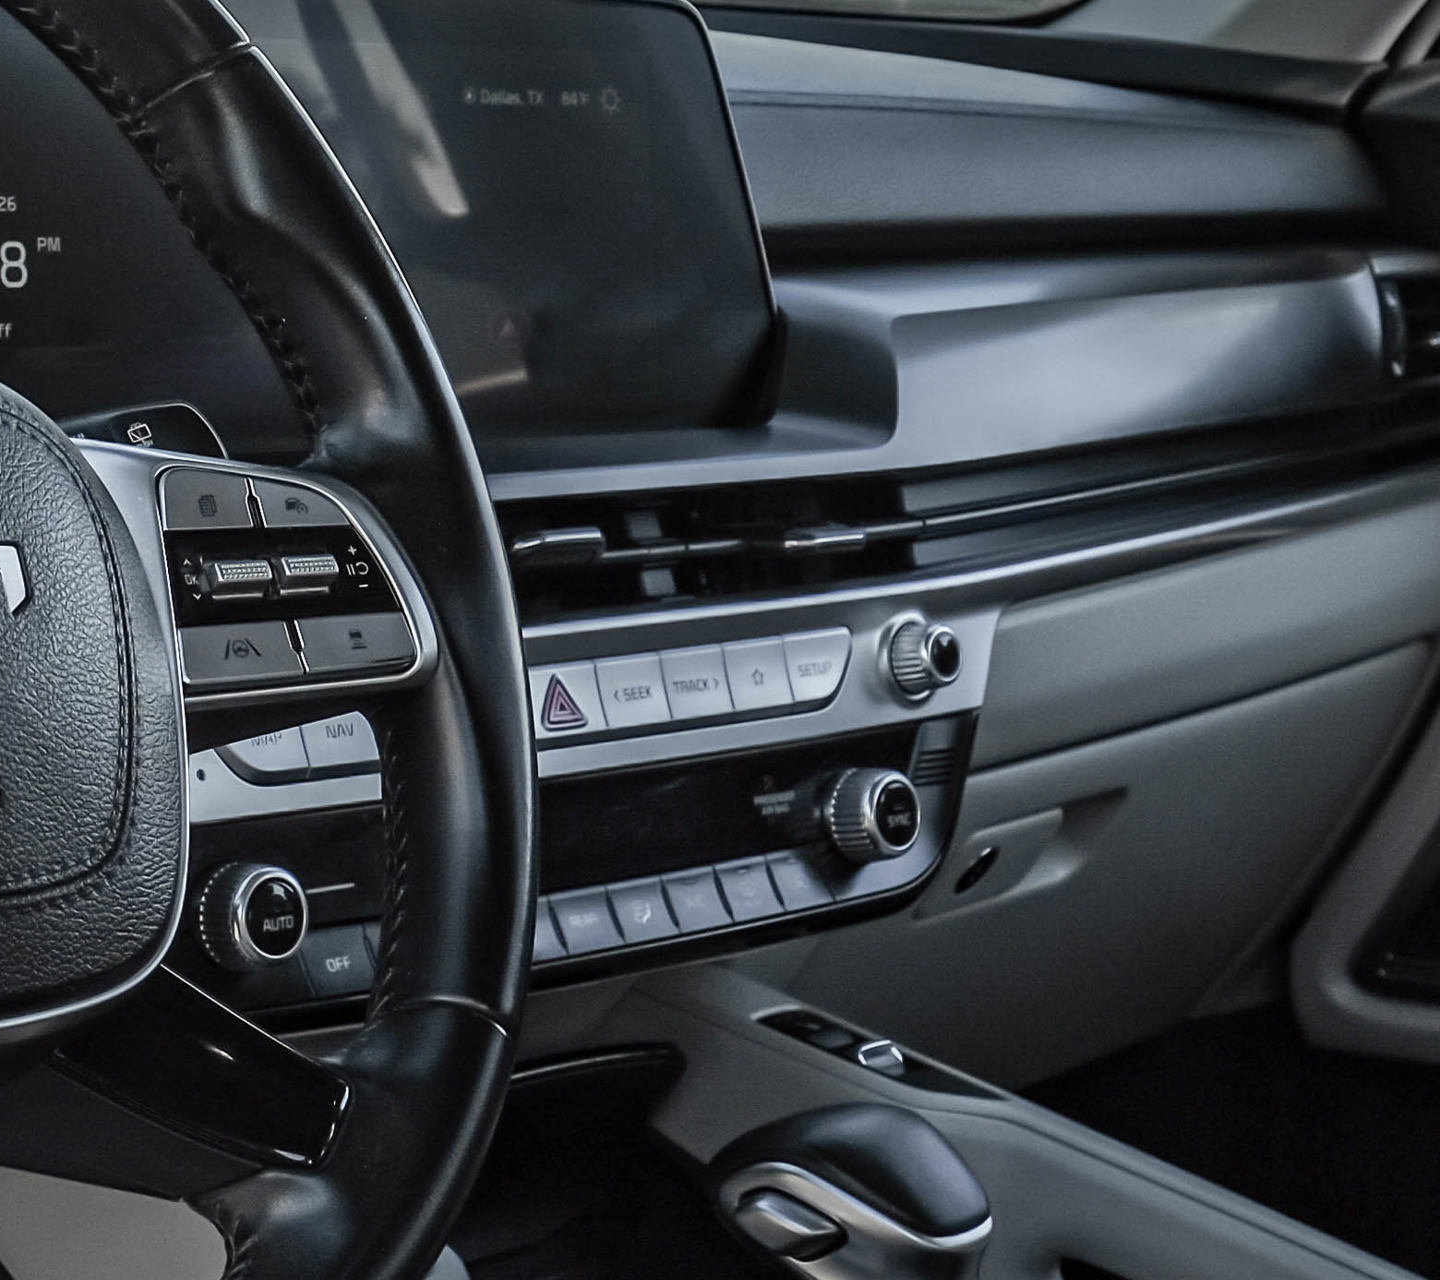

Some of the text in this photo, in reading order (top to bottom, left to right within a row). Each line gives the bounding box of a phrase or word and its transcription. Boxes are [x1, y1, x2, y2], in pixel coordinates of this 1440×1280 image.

[527, 90, 544, 106] TX
[37, 237, 61, 252] PM
[797, 661, 833, 678] SETUP
[623, 686, 653, 702] SEEK
[673, 680, 710, 694] TRACK
[325, 723, 355, 739] NAV
[263, 916, 295, 932] AUTO
[325, 956, 352, 972] OFF
